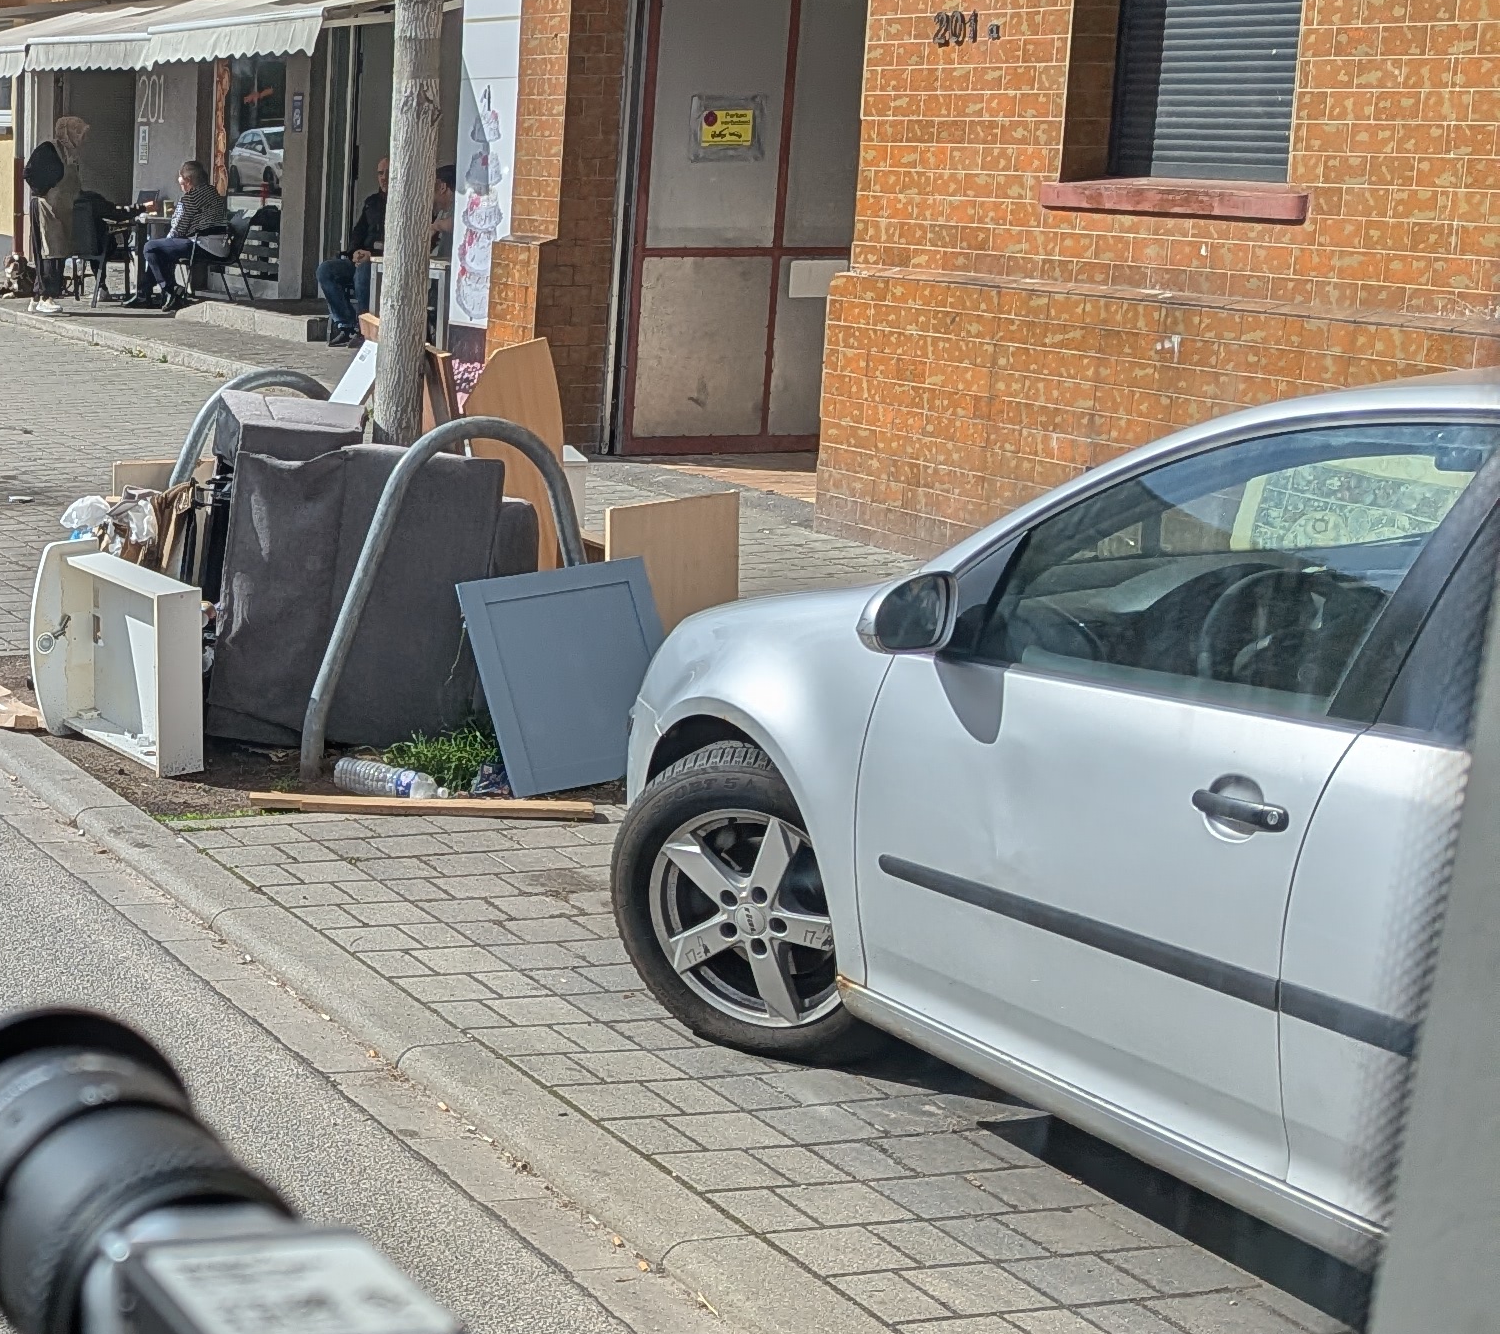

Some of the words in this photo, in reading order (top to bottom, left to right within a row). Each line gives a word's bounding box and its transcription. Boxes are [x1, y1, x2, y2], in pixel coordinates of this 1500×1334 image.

[933, 9, 978, 47] 201
[137, 75, 165, 124] 201
[650, 777, 717, 815] SPORT
[723, 777, 740, 791] 5
